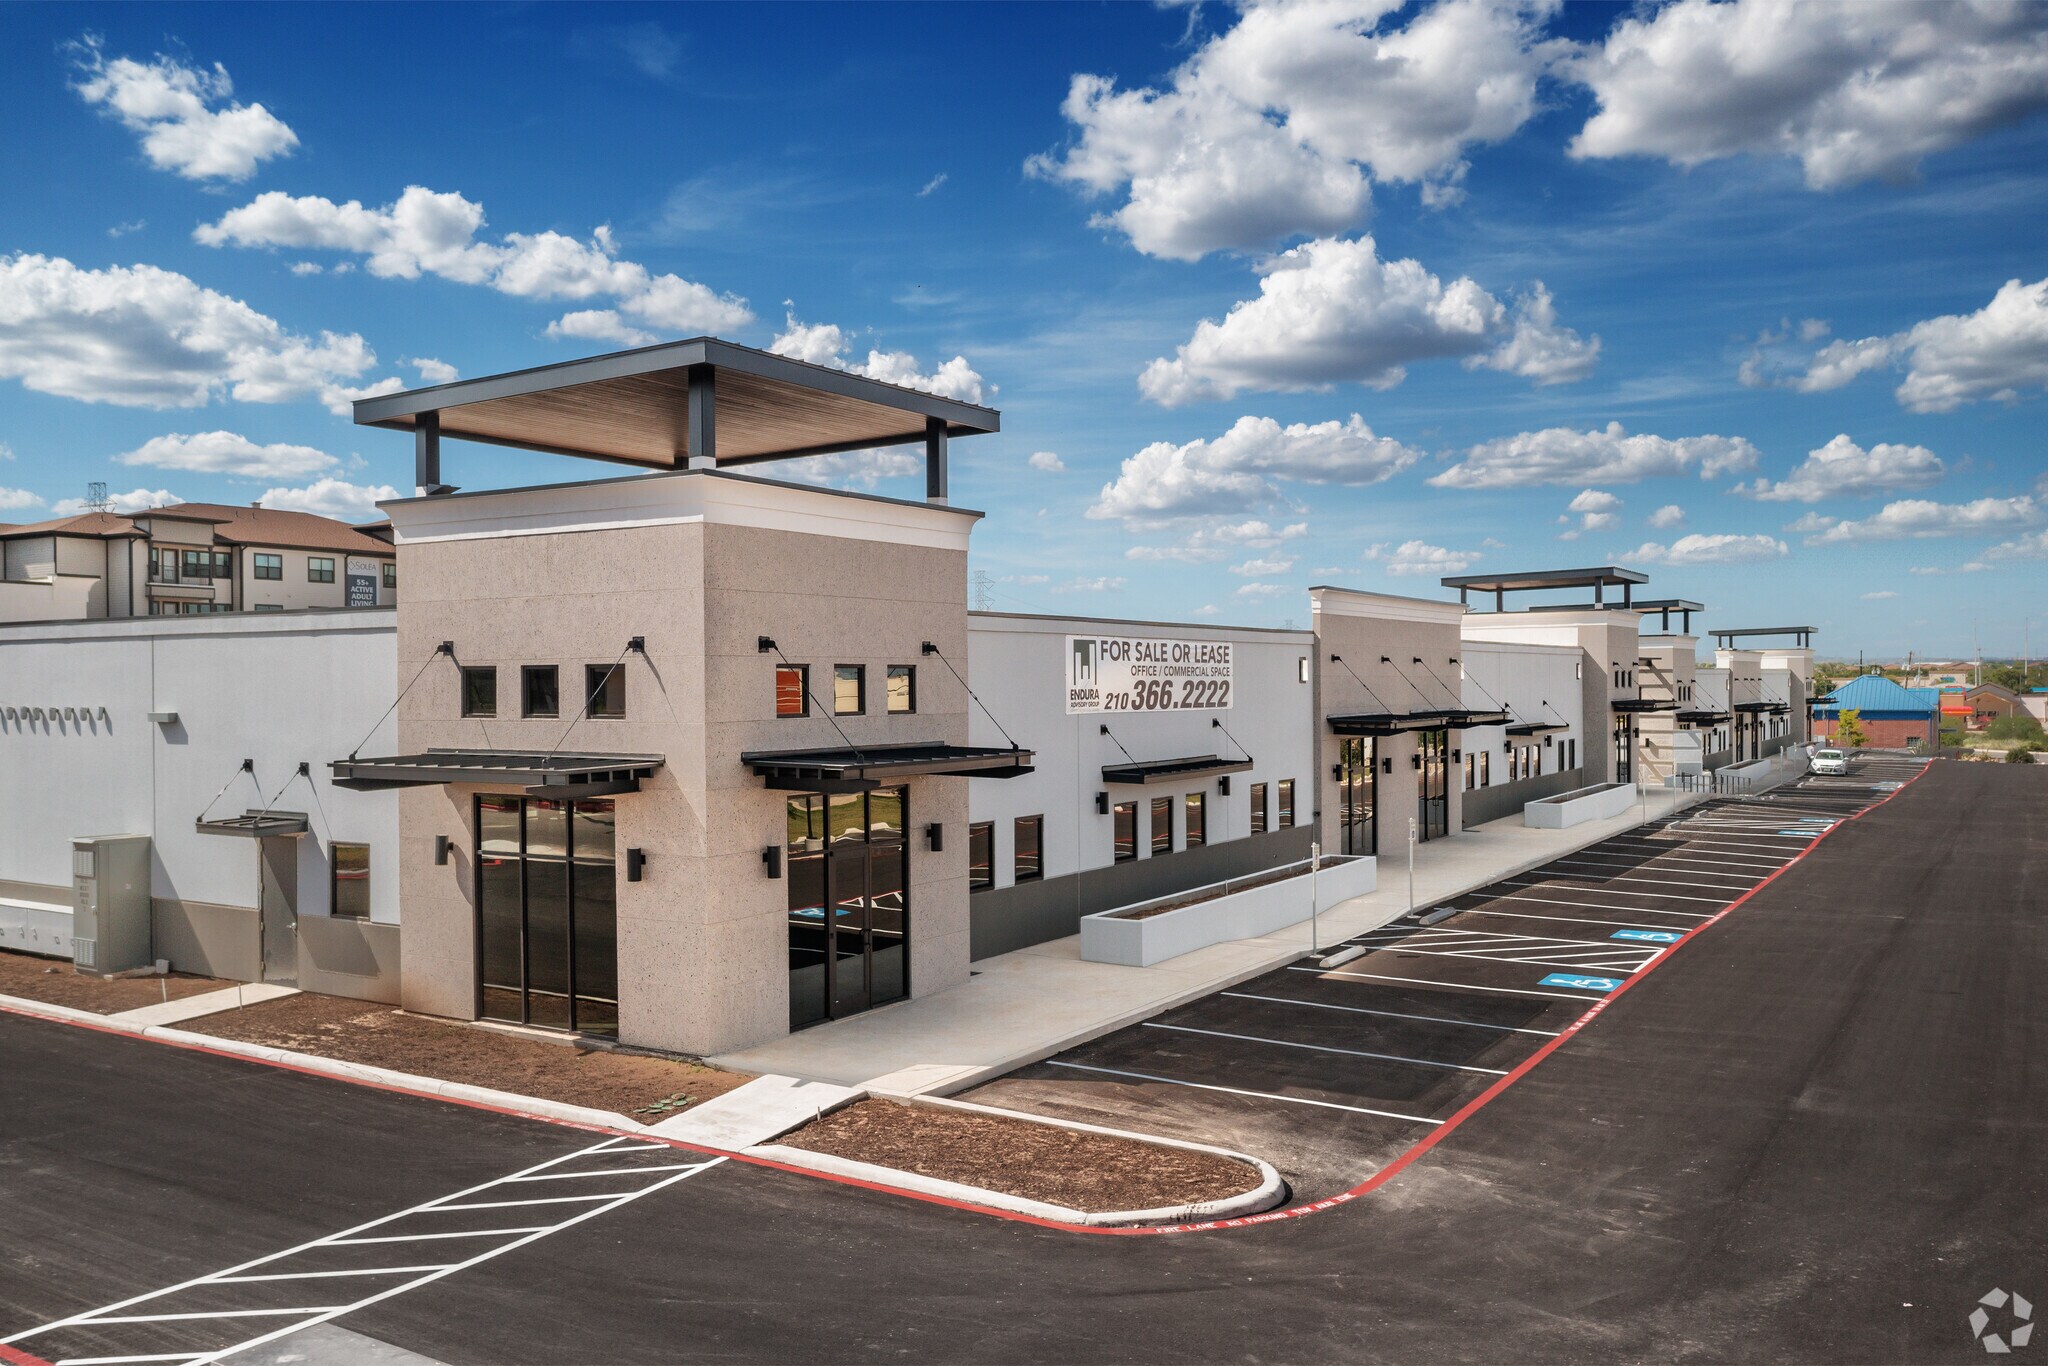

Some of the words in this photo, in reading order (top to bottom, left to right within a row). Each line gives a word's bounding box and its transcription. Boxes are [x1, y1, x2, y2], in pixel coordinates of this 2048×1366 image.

[1100, 640, 1131, 662] FOR
[1135, 642, 1168, 663] SALE
[1172, 643, 1191, 664] OR
[1194, 645, 1230, 664] LEASE
[1130, 665, 1157, 677] OFFICE
[1158, 666, 1163, 677] /
[1163, 667, 1209, 677] COMMERCIAL
[1210, 667, 1230, 677] SPACE
[1070, 689, 1100, 701] ENDURA
[1104, 692, 1129, 710] 210
[1131, 679, 1230, 711] 366.2222
[1187, 1222, 1217, 1231] LANE
[1246, 1212, 1288, 1224] PARKING
